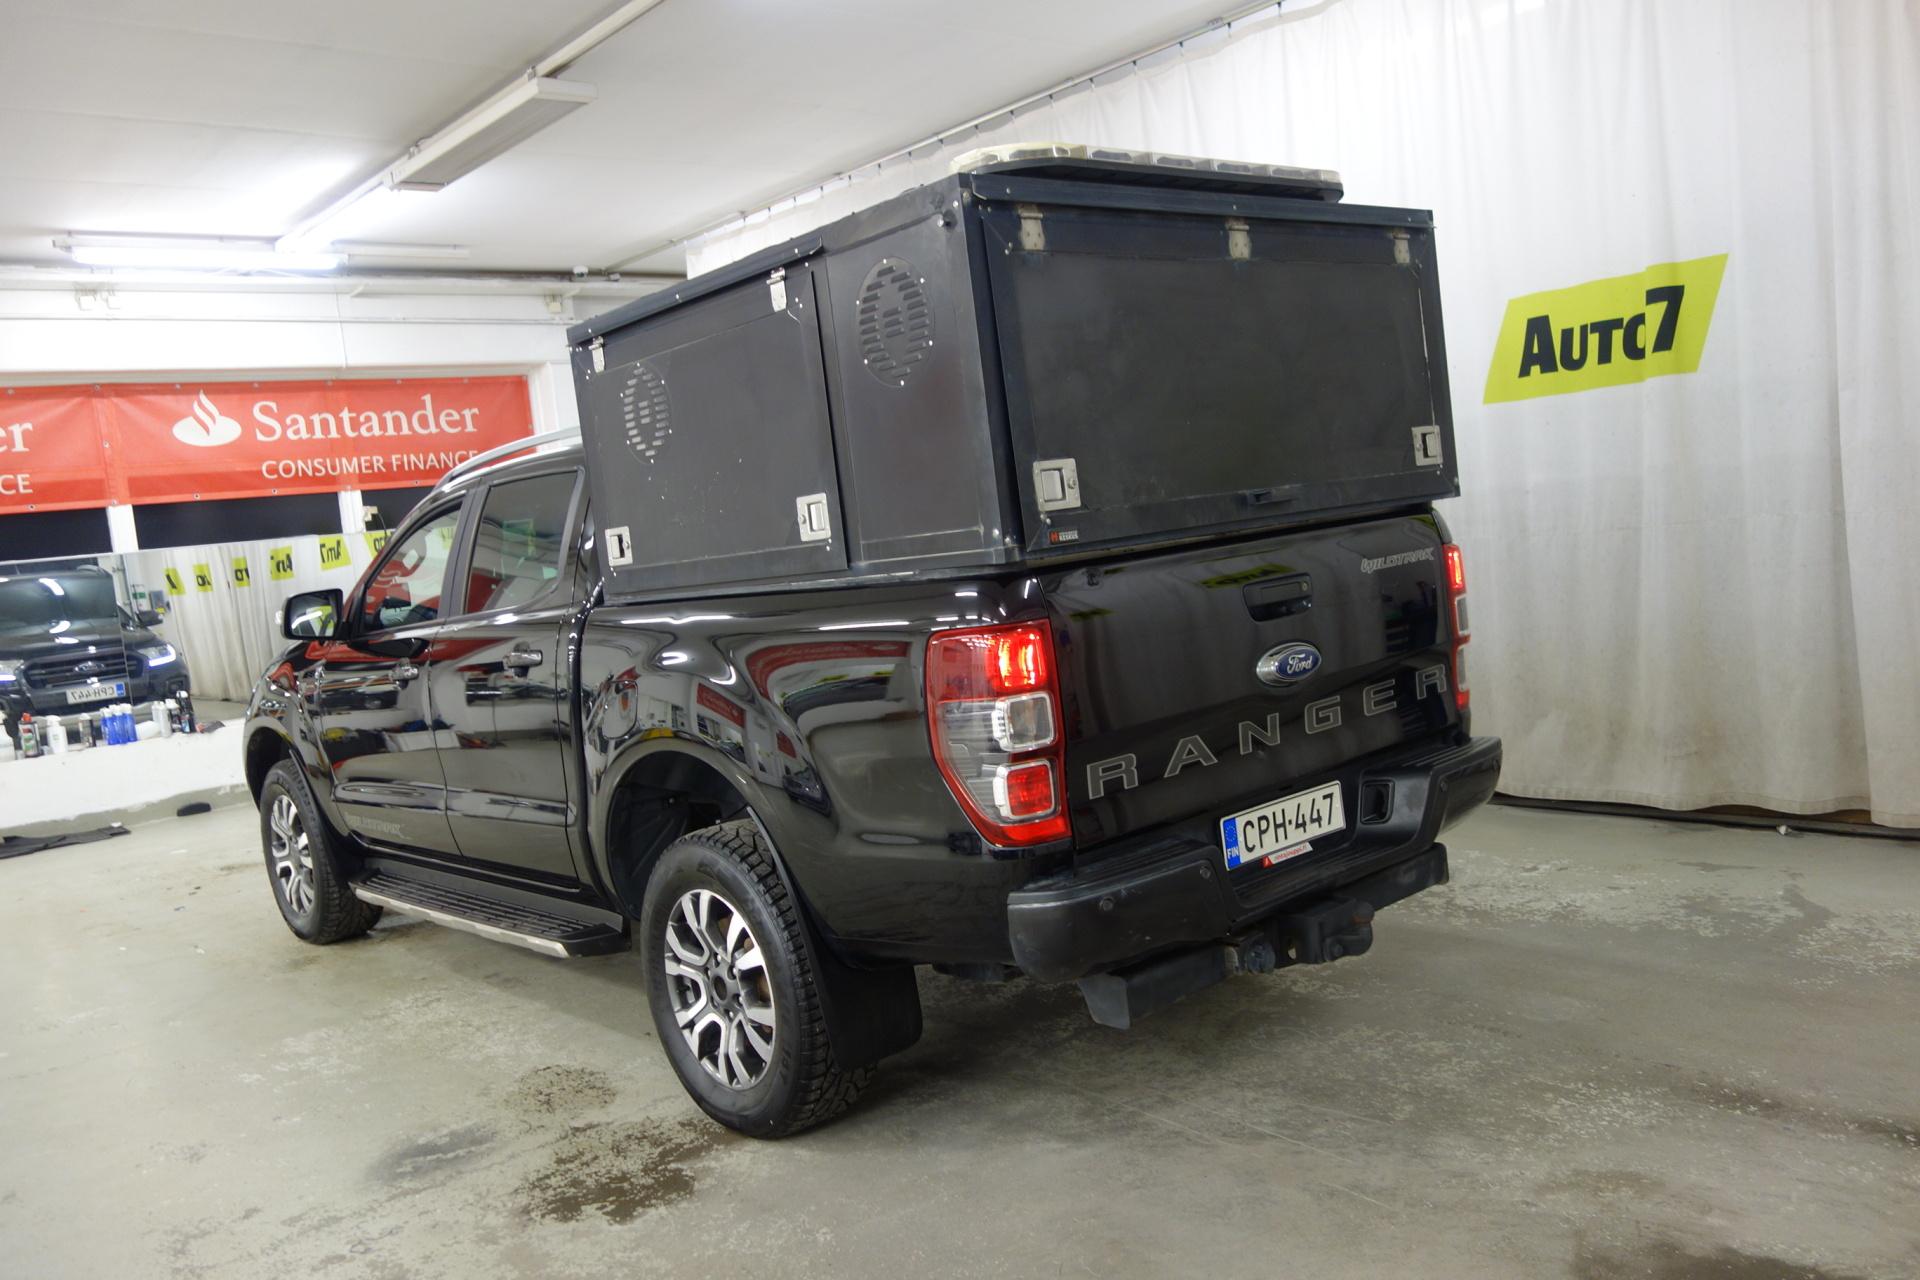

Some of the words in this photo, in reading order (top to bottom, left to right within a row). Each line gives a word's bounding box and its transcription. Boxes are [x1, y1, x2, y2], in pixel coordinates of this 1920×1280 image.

[252, 393, 480, 442] Santander
[261, 456, 386, 480] CONSUMER
[1286, 653, 1313, 674] Ford
[1086, 664, 1448, 800] RANGER
[1226, 846, 1239, 860] FIN
